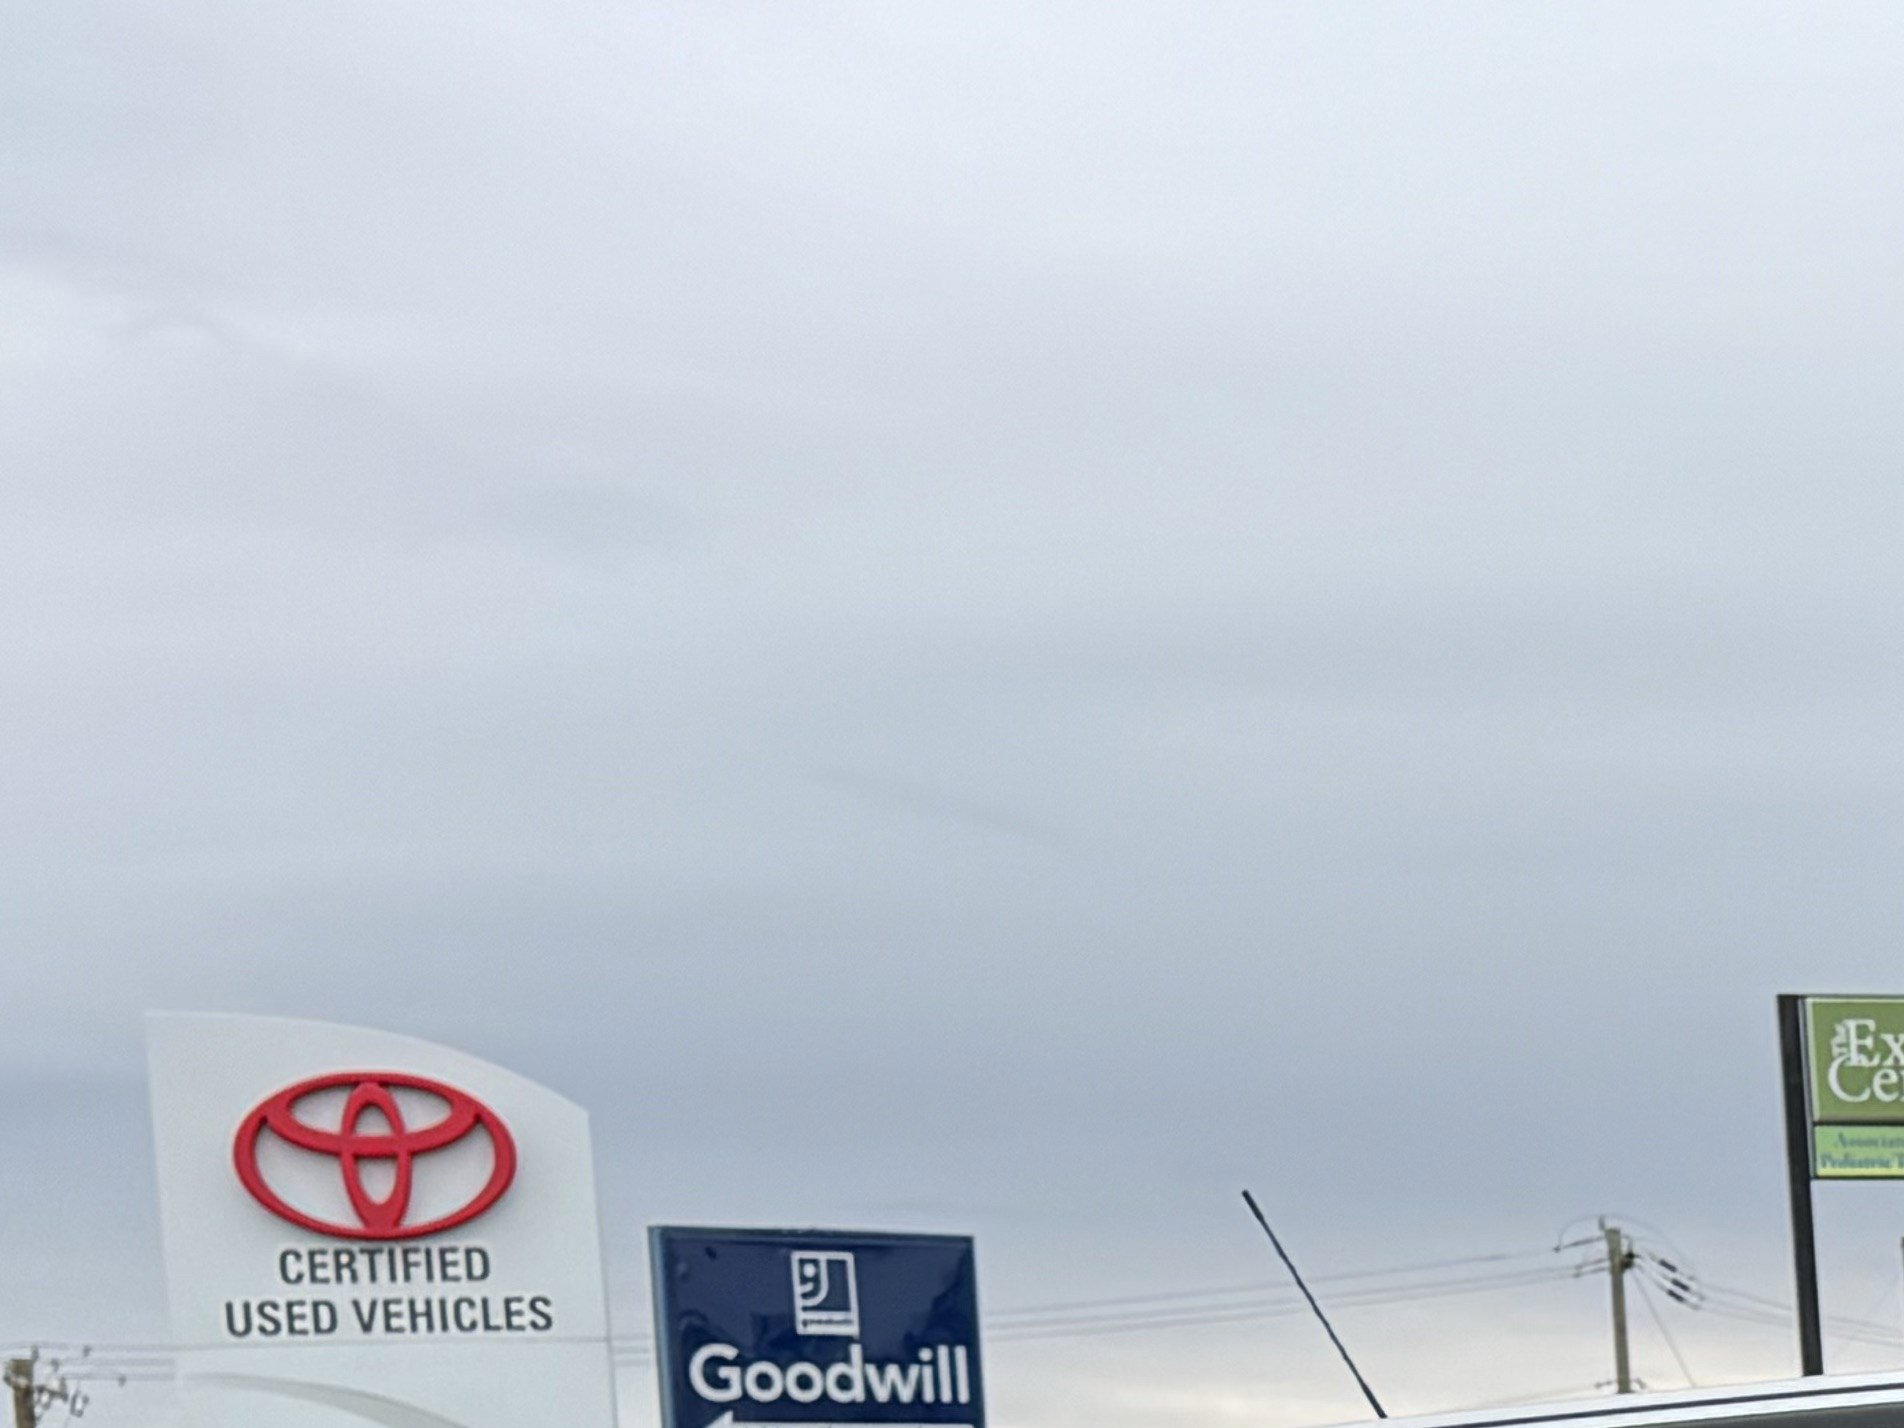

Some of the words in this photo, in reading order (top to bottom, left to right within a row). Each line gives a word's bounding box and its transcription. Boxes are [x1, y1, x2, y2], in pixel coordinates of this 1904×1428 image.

[279, 1246, 491, 1285] CERTIFIED
[225, 1300, 338, 1338] USED
[353, 1296, 554, 1334] VEHICLES
[689, 1343, 970, 1404] Goodwill
